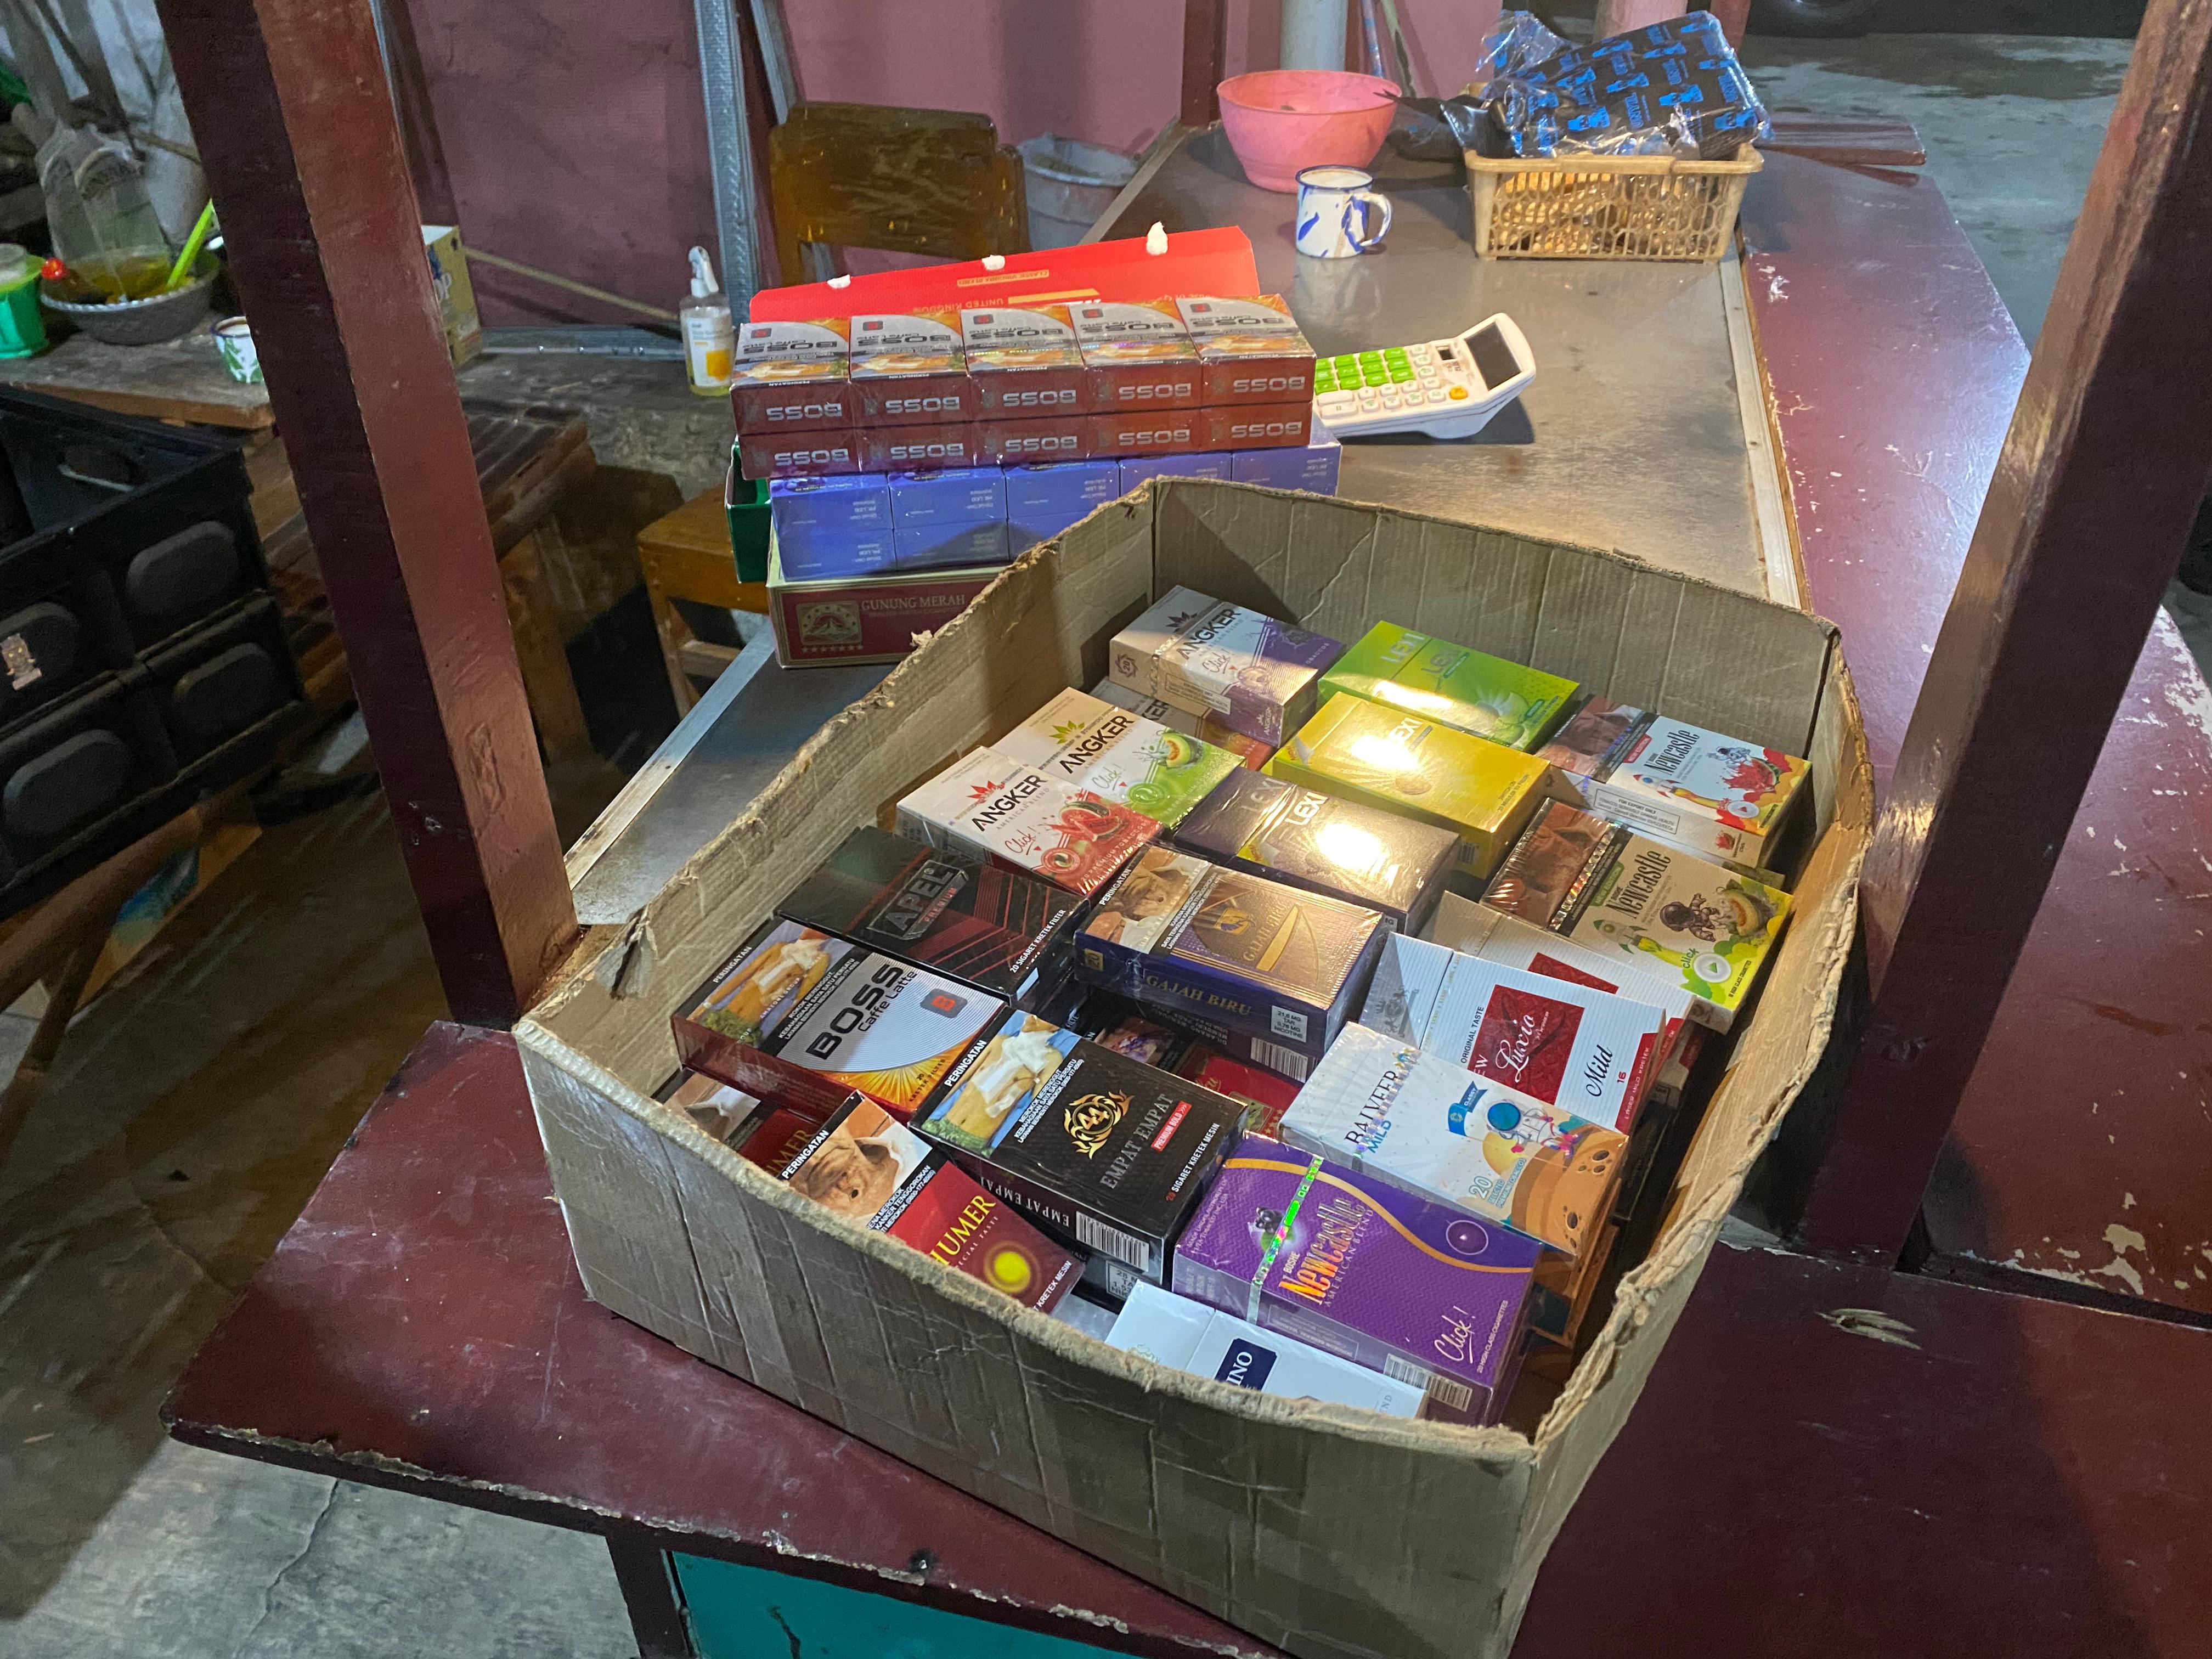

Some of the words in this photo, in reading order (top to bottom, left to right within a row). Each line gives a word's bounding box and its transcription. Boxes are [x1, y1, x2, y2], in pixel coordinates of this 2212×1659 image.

[966, 298, 1003, 308] UNITED
[1003, 389, 1076, 407] BOSS
[1119, 383, 1191, 400] BOSS
[1233, 376, 1305, 393] BOSS
[766, 402, 842, 421] BOSS
[885, 396, 960, 414] BOSS
[1005, 436, 1077, 453] BOSS
[1119, 429, 1190, 446] BOSS
[1231, 421, 1302, 438] BOSS
[774, 448, 849, 466] BOSS
[890, 443, 963, 460] BOSS
[861, 597, 917, 612] GUNUNG
[919, 594, 966, 607] MERAH
[1176, 608, 1242, 661] ANGKER
[1059, 714, 1135, 774] ANGKER
[1644, 730, 1700, 776] Newcastle
[972, 774, 1048, 832] ANGKER
[1285, 792, 1328, 826] LEXI
[885, 868, 955, 933] APEL
[1099, 867, 1132, 905] PERINGATAN
[1606, 850, 1671, 919] Newcastle
[924, 887, 957, 923] PREMIUM
[1010, 963, 1020, 974] 20
[1018, 943, 1037, 966] SIGARET
[1034, 924, 1052, 946] KRETEK
[1048, 909, 1066, 929] FILTER
[1161, 934, 1173, 949] SAYA
[1243, 927, 1268, 962] GAJAH
[1680, 948, 1700, 968] click
[714, 946, 752, 984] PERINGATAN
[778, 1002, 813, 1038] KEBAHAGIAAN
[822, 977, 836, 991] SATU
[833, 958, 855, 979] PERSATU
[805, 963, 905, 1060] BOSS
[857, 998, 891, 1032] Caffe
[887, 970, 918, 1002] Latte
[1146, 975, 1204, 1001] GAJAH
[1206, 994, 1252, 1015] BIRU
[1274, 1025, 1304, 1039] NICOTINE
[1460, 1027, 1479, 1064] ORIGINAL
[1473, 1006, 1485, 1029] TASTE
[1494, 1013, 1536, 1084] Luxio
[945, 1040, 988, 1087] PERINGATAN
[1585, 1043, 1613, 1098] Mild
[1616, 1070, 1627, 1085] 16
[1014, 1104, 1043, 1138] KEBAHAGIAAN
[1040, 1091, 1052, 1105] SAYA
[1049, 1079, 1062, 1095] SATU
[1059, 1058, 1077, 1082] PERSATU
[1019, 1097, 1041, 1124] MEROKOK
[1037, 1069, 1062, 1099] MERENGGUT
[1463, 1086, 1478, 1108] CLASSY
[1078, 1107, 1110, 1130] 44
[1153, 1120, 1173, 1150] PREMIUM
[1169, 1110, 1183, 1127] BOLD
[1368, 1119, 1392, 1154] MILD
[782, 1130, 830, 1180] PERINGATAN
[1099, 1139, 1137, 1189] EMPAT
[1132, 1092, 1174, 1144] EMPAT
[1171, 1165, 1192, 1194] SIGARET
[1188, 1143, 1207, 1170] KRETEK
[1203, 1122, 1221, 1149] MESIN
[874, 1206, 897, 1230] KANKER
[894, 1165, 932, 1206] TENGGOROKAN
[878, 1187, 905, 1216] MEROKOK
[1469, 1176, 1492, 1199] 20
[885, 1204, 909, 1228] MEROKOK
[1015, 1193, 1070, 1227] EMPAT
[979, 1216, 1000, 1242] TASTE
[1278, 1197, 1367, 1306] Newcastle
[1282, 1251, 1301, 1276] BOSHE
[1324, 1246, 1356, 1307] AMERICAN
[1350, 1209, 1374, 1247] BLEND
[1036, 1278, 1060, 1309] KRETEK
[1054, 1261, 1073, 1284] MESIN
[1480, 1350, 1491, 1367] HIGH
[1486, 1333, 1498, 1352] CLASS
[1492, 1299, 1509, 1335] CIGARETTES
